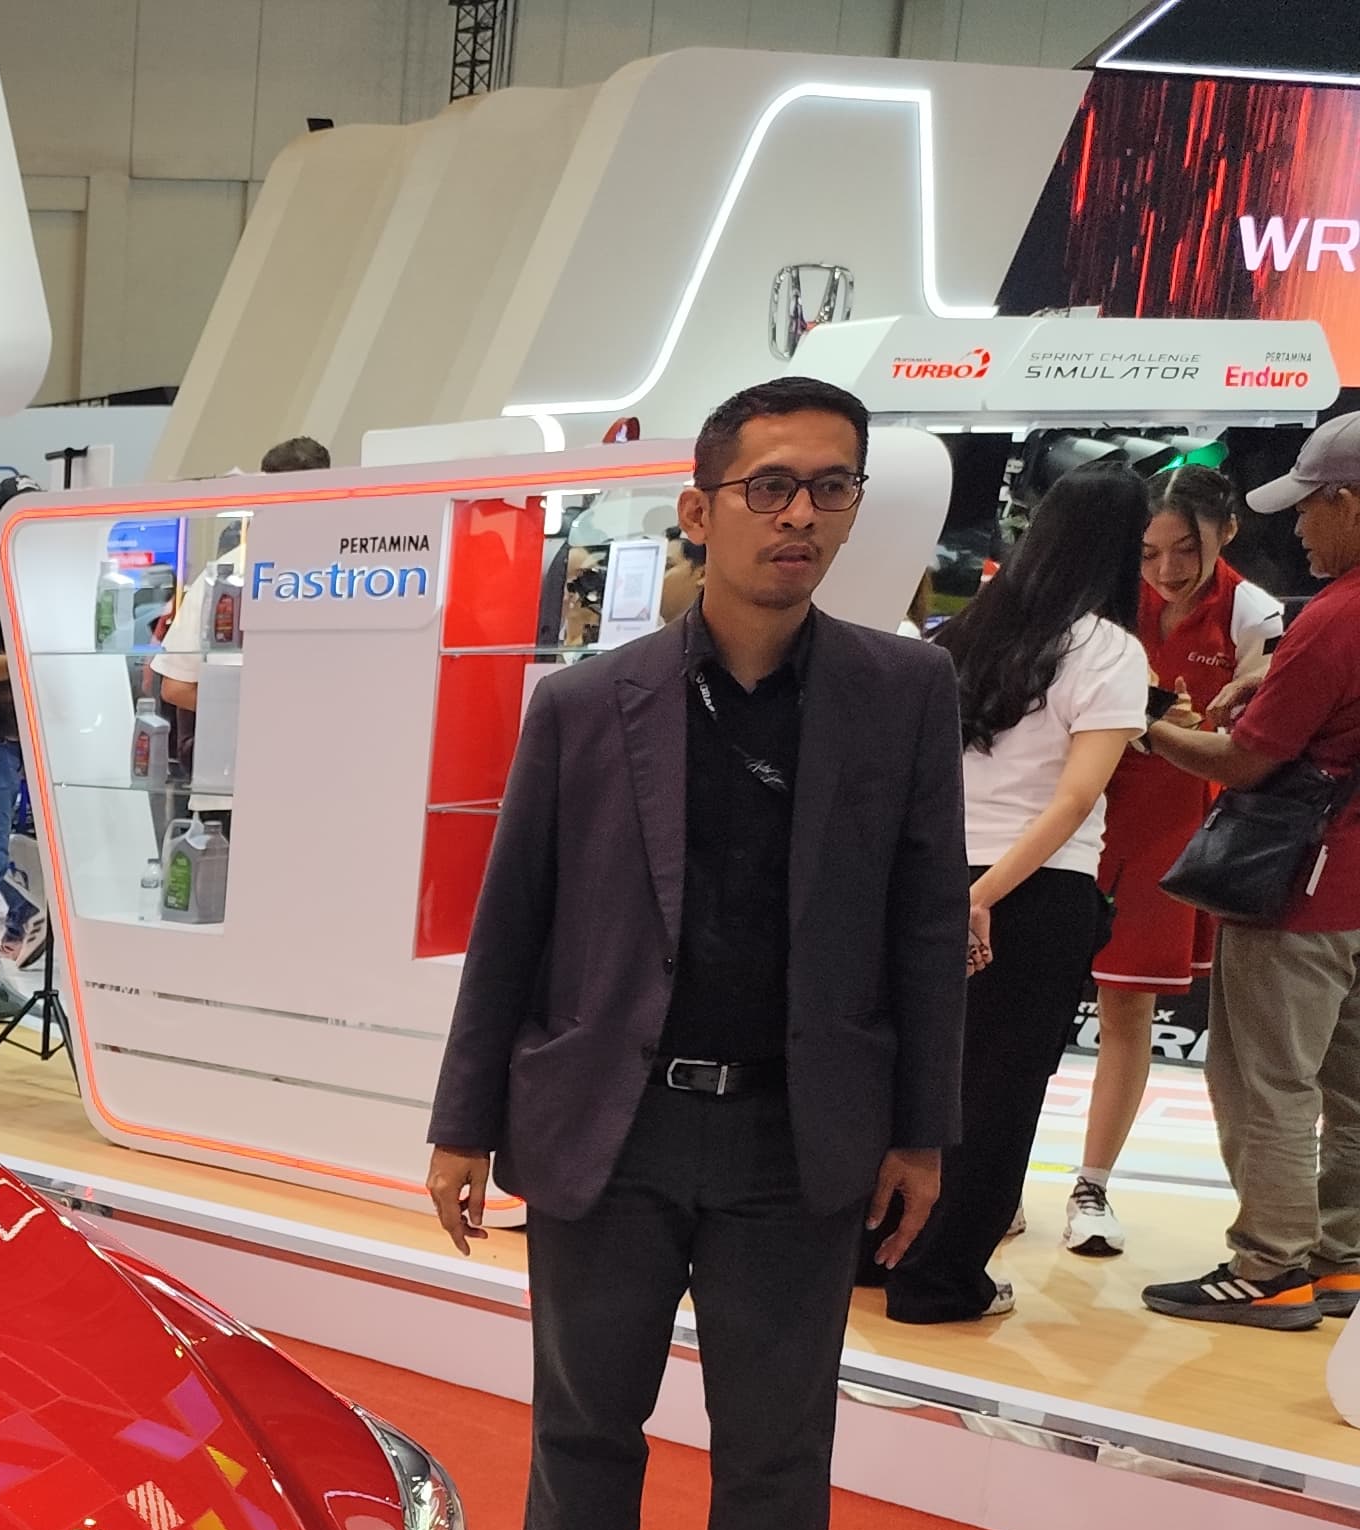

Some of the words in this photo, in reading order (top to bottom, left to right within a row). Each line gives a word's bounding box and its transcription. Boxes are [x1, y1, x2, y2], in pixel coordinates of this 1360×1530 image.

[1030, 352, 1095, 362] SPRINT
[1099, 352, 1201, 363] CHALLENGE
[1265, 351, 1312, 362] PERTAMINA
[891, 363, 974, 379] TURBO
[1024, 365, 1200, 380] SIMULATOR
[1224, 365, 1309, 389] Enduro
[339, 534, 430, 555] PERTAMINA
[250, 560, 428, 601] Fastron
